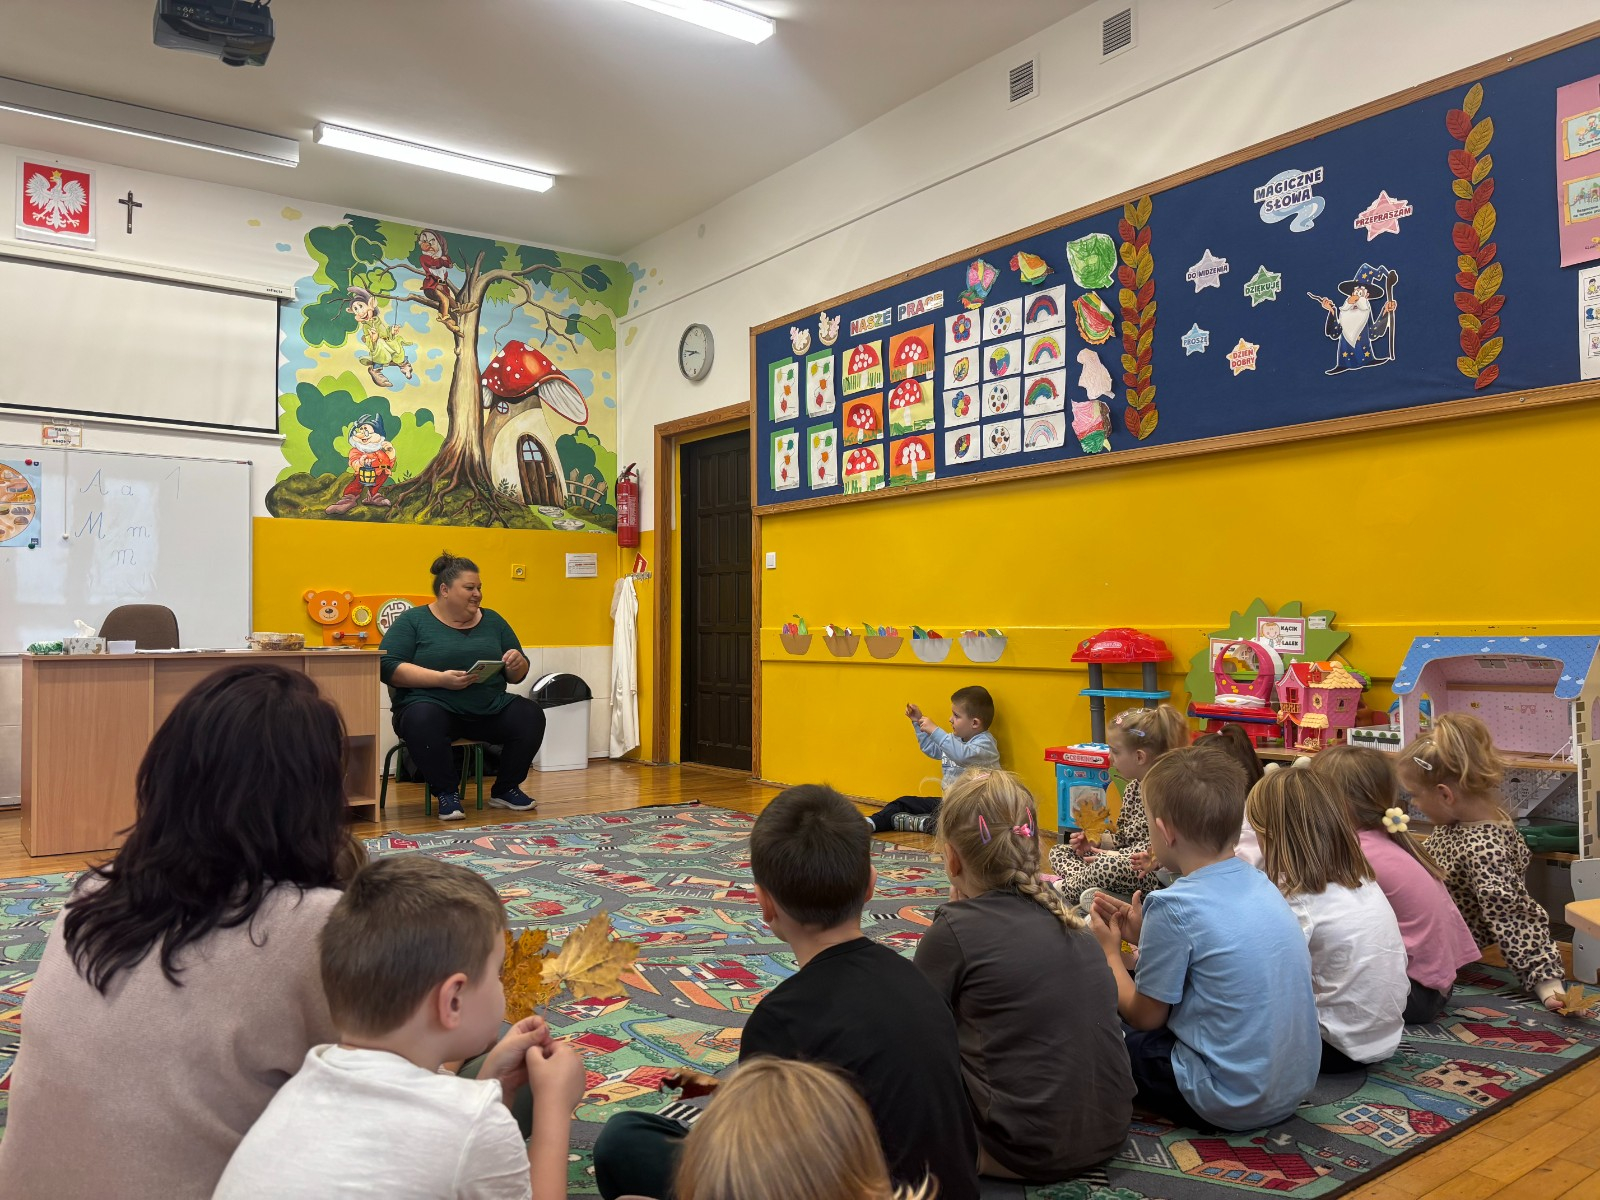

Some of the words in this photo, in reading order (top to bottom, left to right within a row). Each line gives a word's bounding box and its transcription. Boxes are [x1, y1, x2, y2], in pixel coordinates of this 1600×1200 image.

[1255, 169, 1322, 201] MAGICZNE
[1265, 188, 1311, 212] SŁOWA
[1355, 207, 1411, 227] PRZEPRASZAM
[1187, 272, 1197, 280] DO
[1245, 281, 1280, 295] DZIĘKUJĘ
[851, 310, 892, 335] NASZE
[1231, 357, 1255, 368] DOBRY
[75, 511, 106, 539] M
